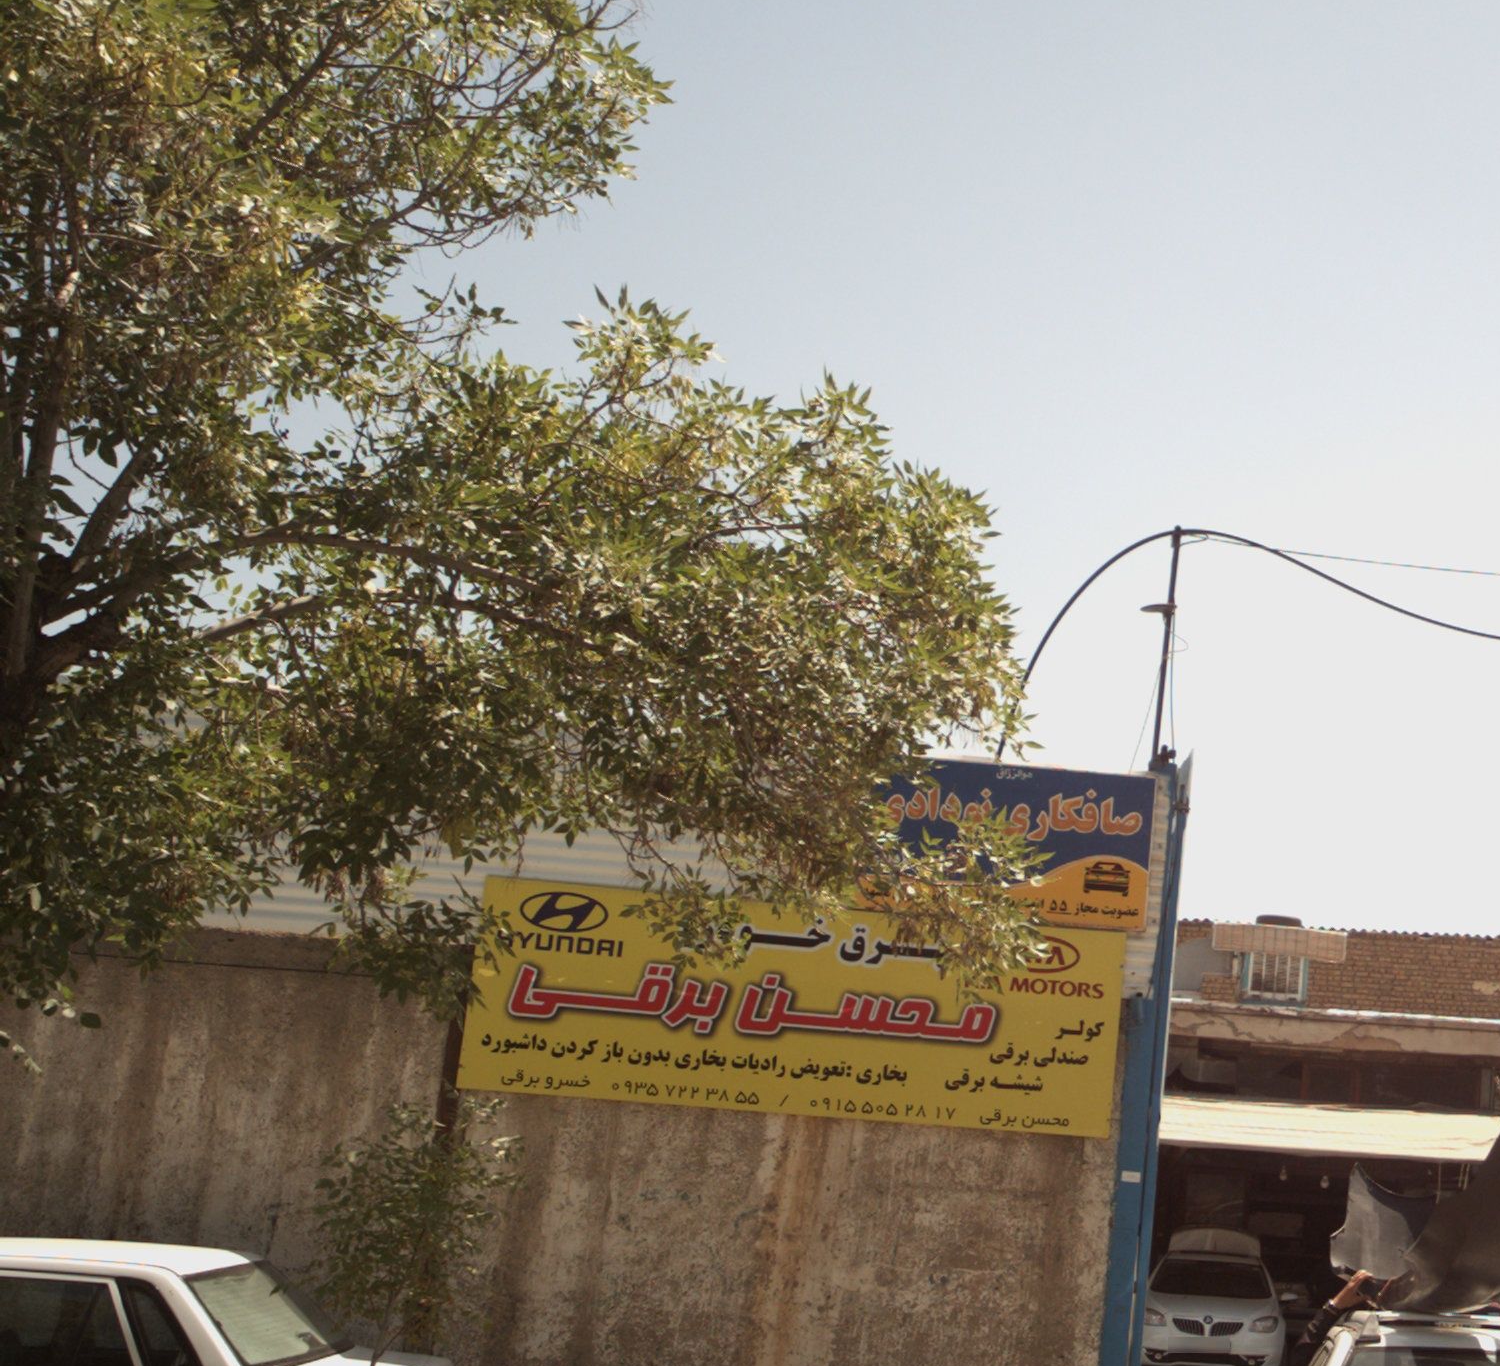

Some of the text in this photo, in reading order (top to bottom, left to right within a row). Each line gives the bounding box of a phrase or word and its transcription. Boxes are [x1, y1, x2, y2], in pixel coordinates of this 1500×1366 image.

[1001, 787, 1143, 842] صافکاری
[1074, 902, 1099, 916] مجاز
[1009, 976, 1105, 999] MOTORS
[508, 962, 996, 1043] محسن برقی
[1055, 1019, 1105, 1041] کولر
[481, 1033, 547, 1054] داشبورد
[551, 1038, 598, 1060] کردن
[601, 1040, 625, 1062] باز
[989, 1042, 1088, 1067] صندلی برقی
[628, 1046, 671, 1066] بدون
[674, 1048, 727, 1071] بخاری
[501, 1068, 541, 1088] برقی
[544, 1073, 591, 1090] خسرو
[856, 1064, 908, 1085] بخاری
[944, 1067, 1044, 1095] شیشه برقی
[979, 1108, 1017, 1127] برقی
[1021, 1113, 1070, 1129] محسن
